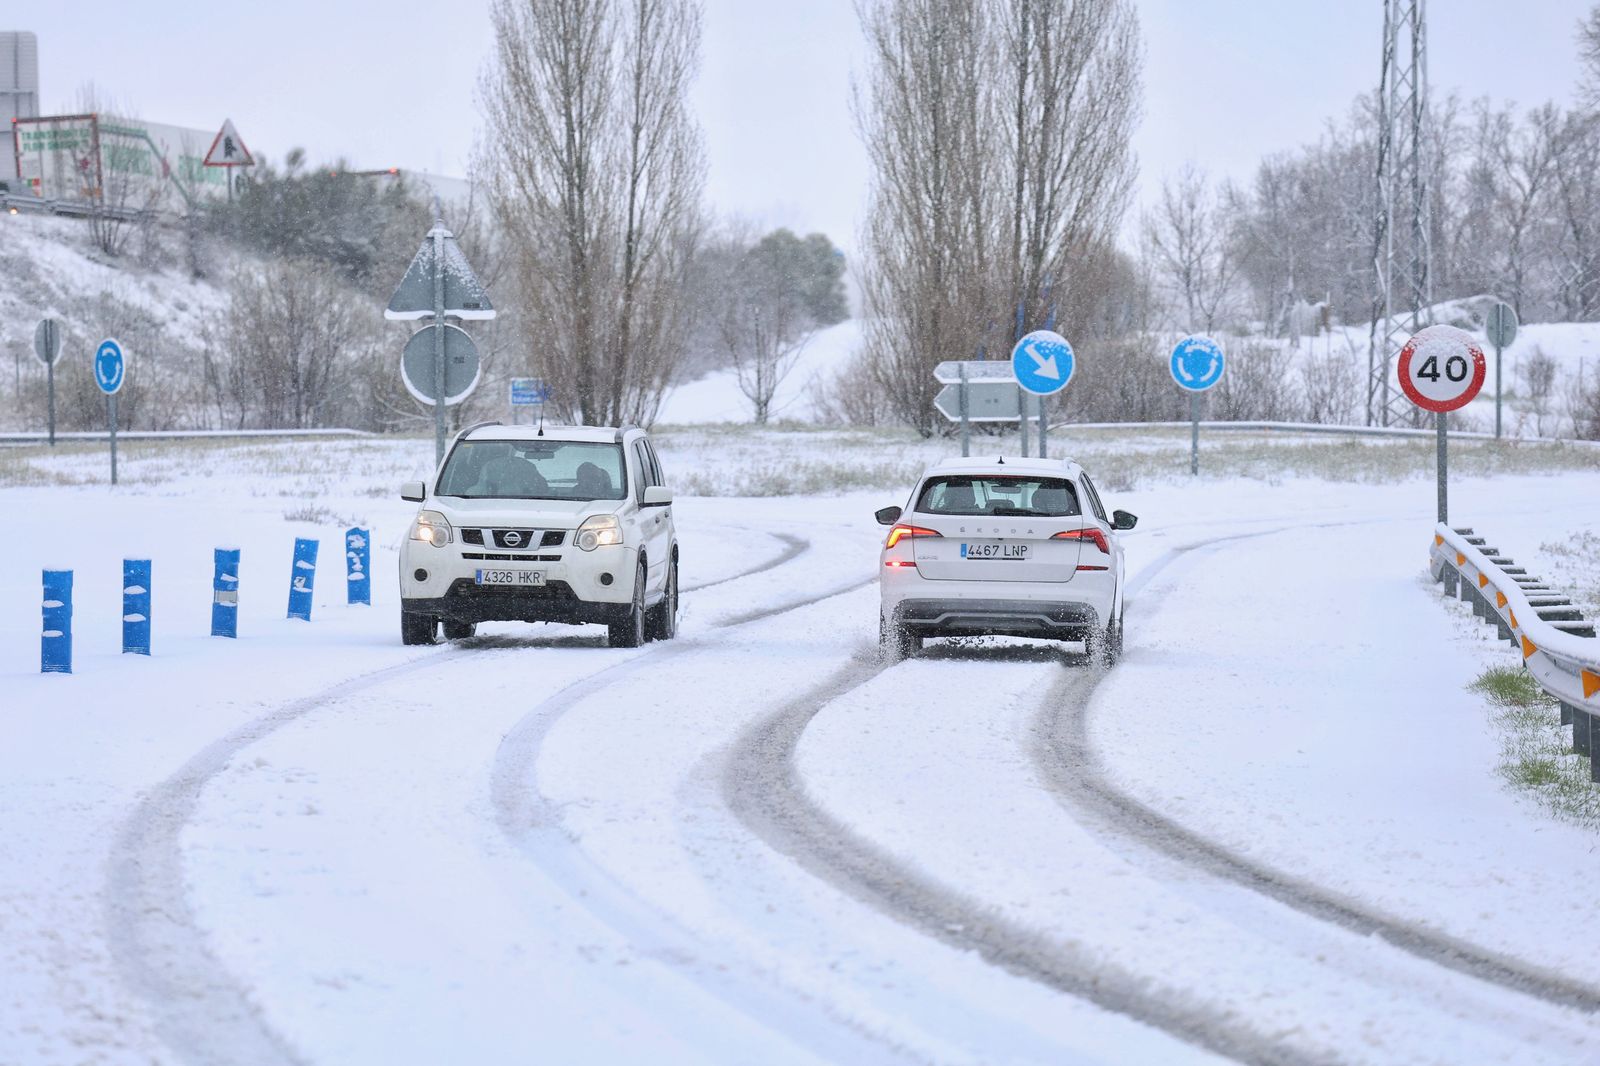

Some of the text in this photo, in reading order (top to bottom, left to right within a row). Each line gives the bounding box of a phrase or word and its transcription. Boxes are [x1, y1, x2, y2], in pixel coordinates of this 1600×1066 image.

[1417, 356, 1467, 382] 40
[968, 545, 1028, 557] 4467 LNP
[484, 571, 541, 584] 4326 HKR
